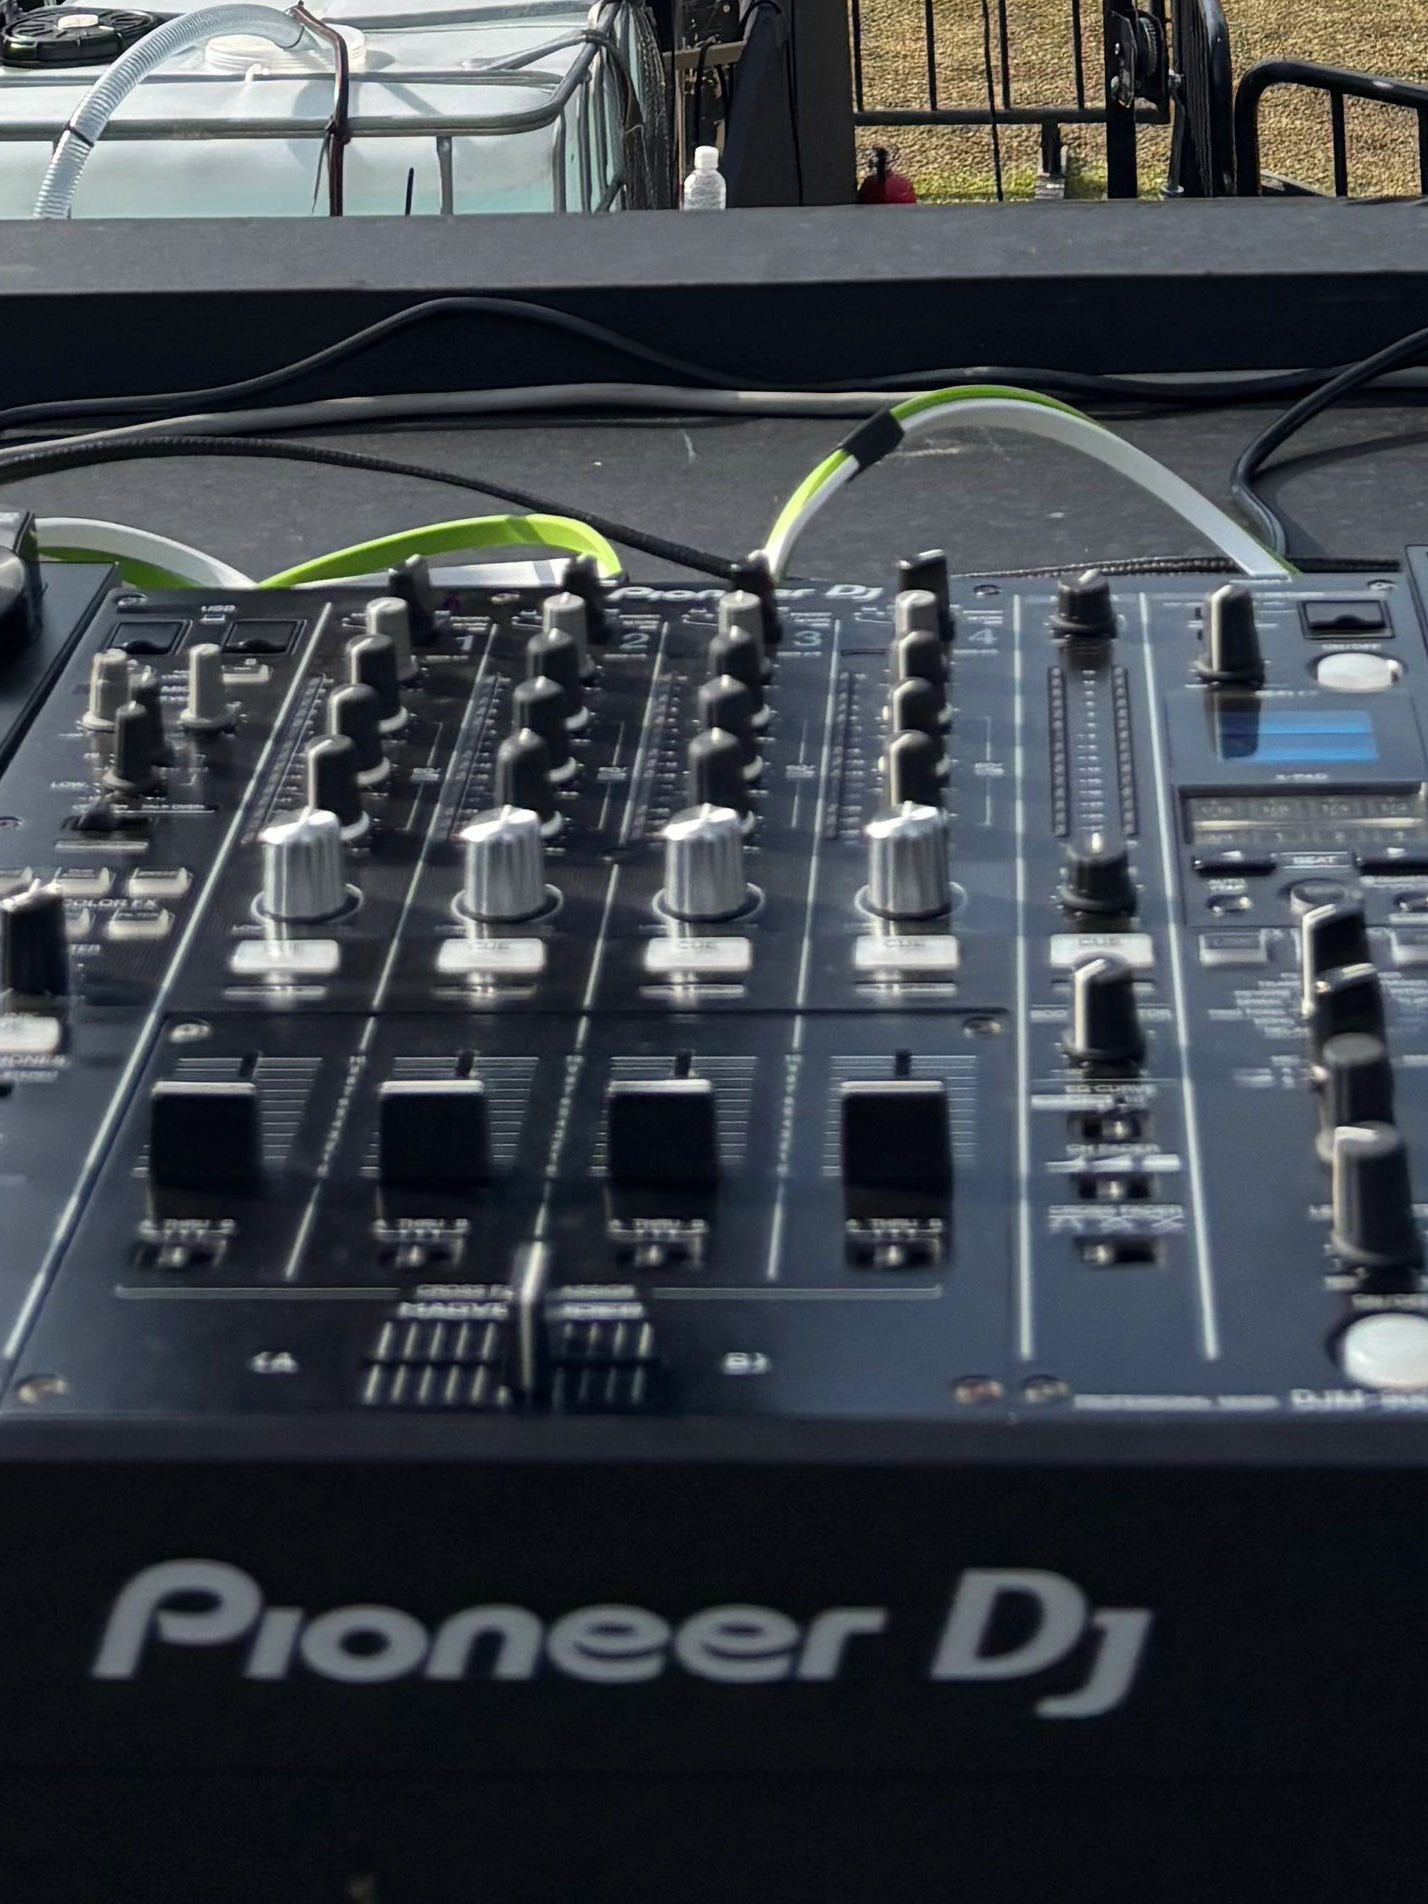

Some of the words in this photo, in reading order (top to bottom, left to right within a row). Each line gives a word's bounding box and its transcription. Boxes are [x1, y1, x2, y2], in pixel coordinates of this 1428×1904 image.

[621, 632, 651, 649] 2
[794, 630, 822, 647] 3
[968, 629, 998, 645] 4
[91, 1557, 888, 1683] Pioneer
[928, 1567, 1152, 1719] DJ
